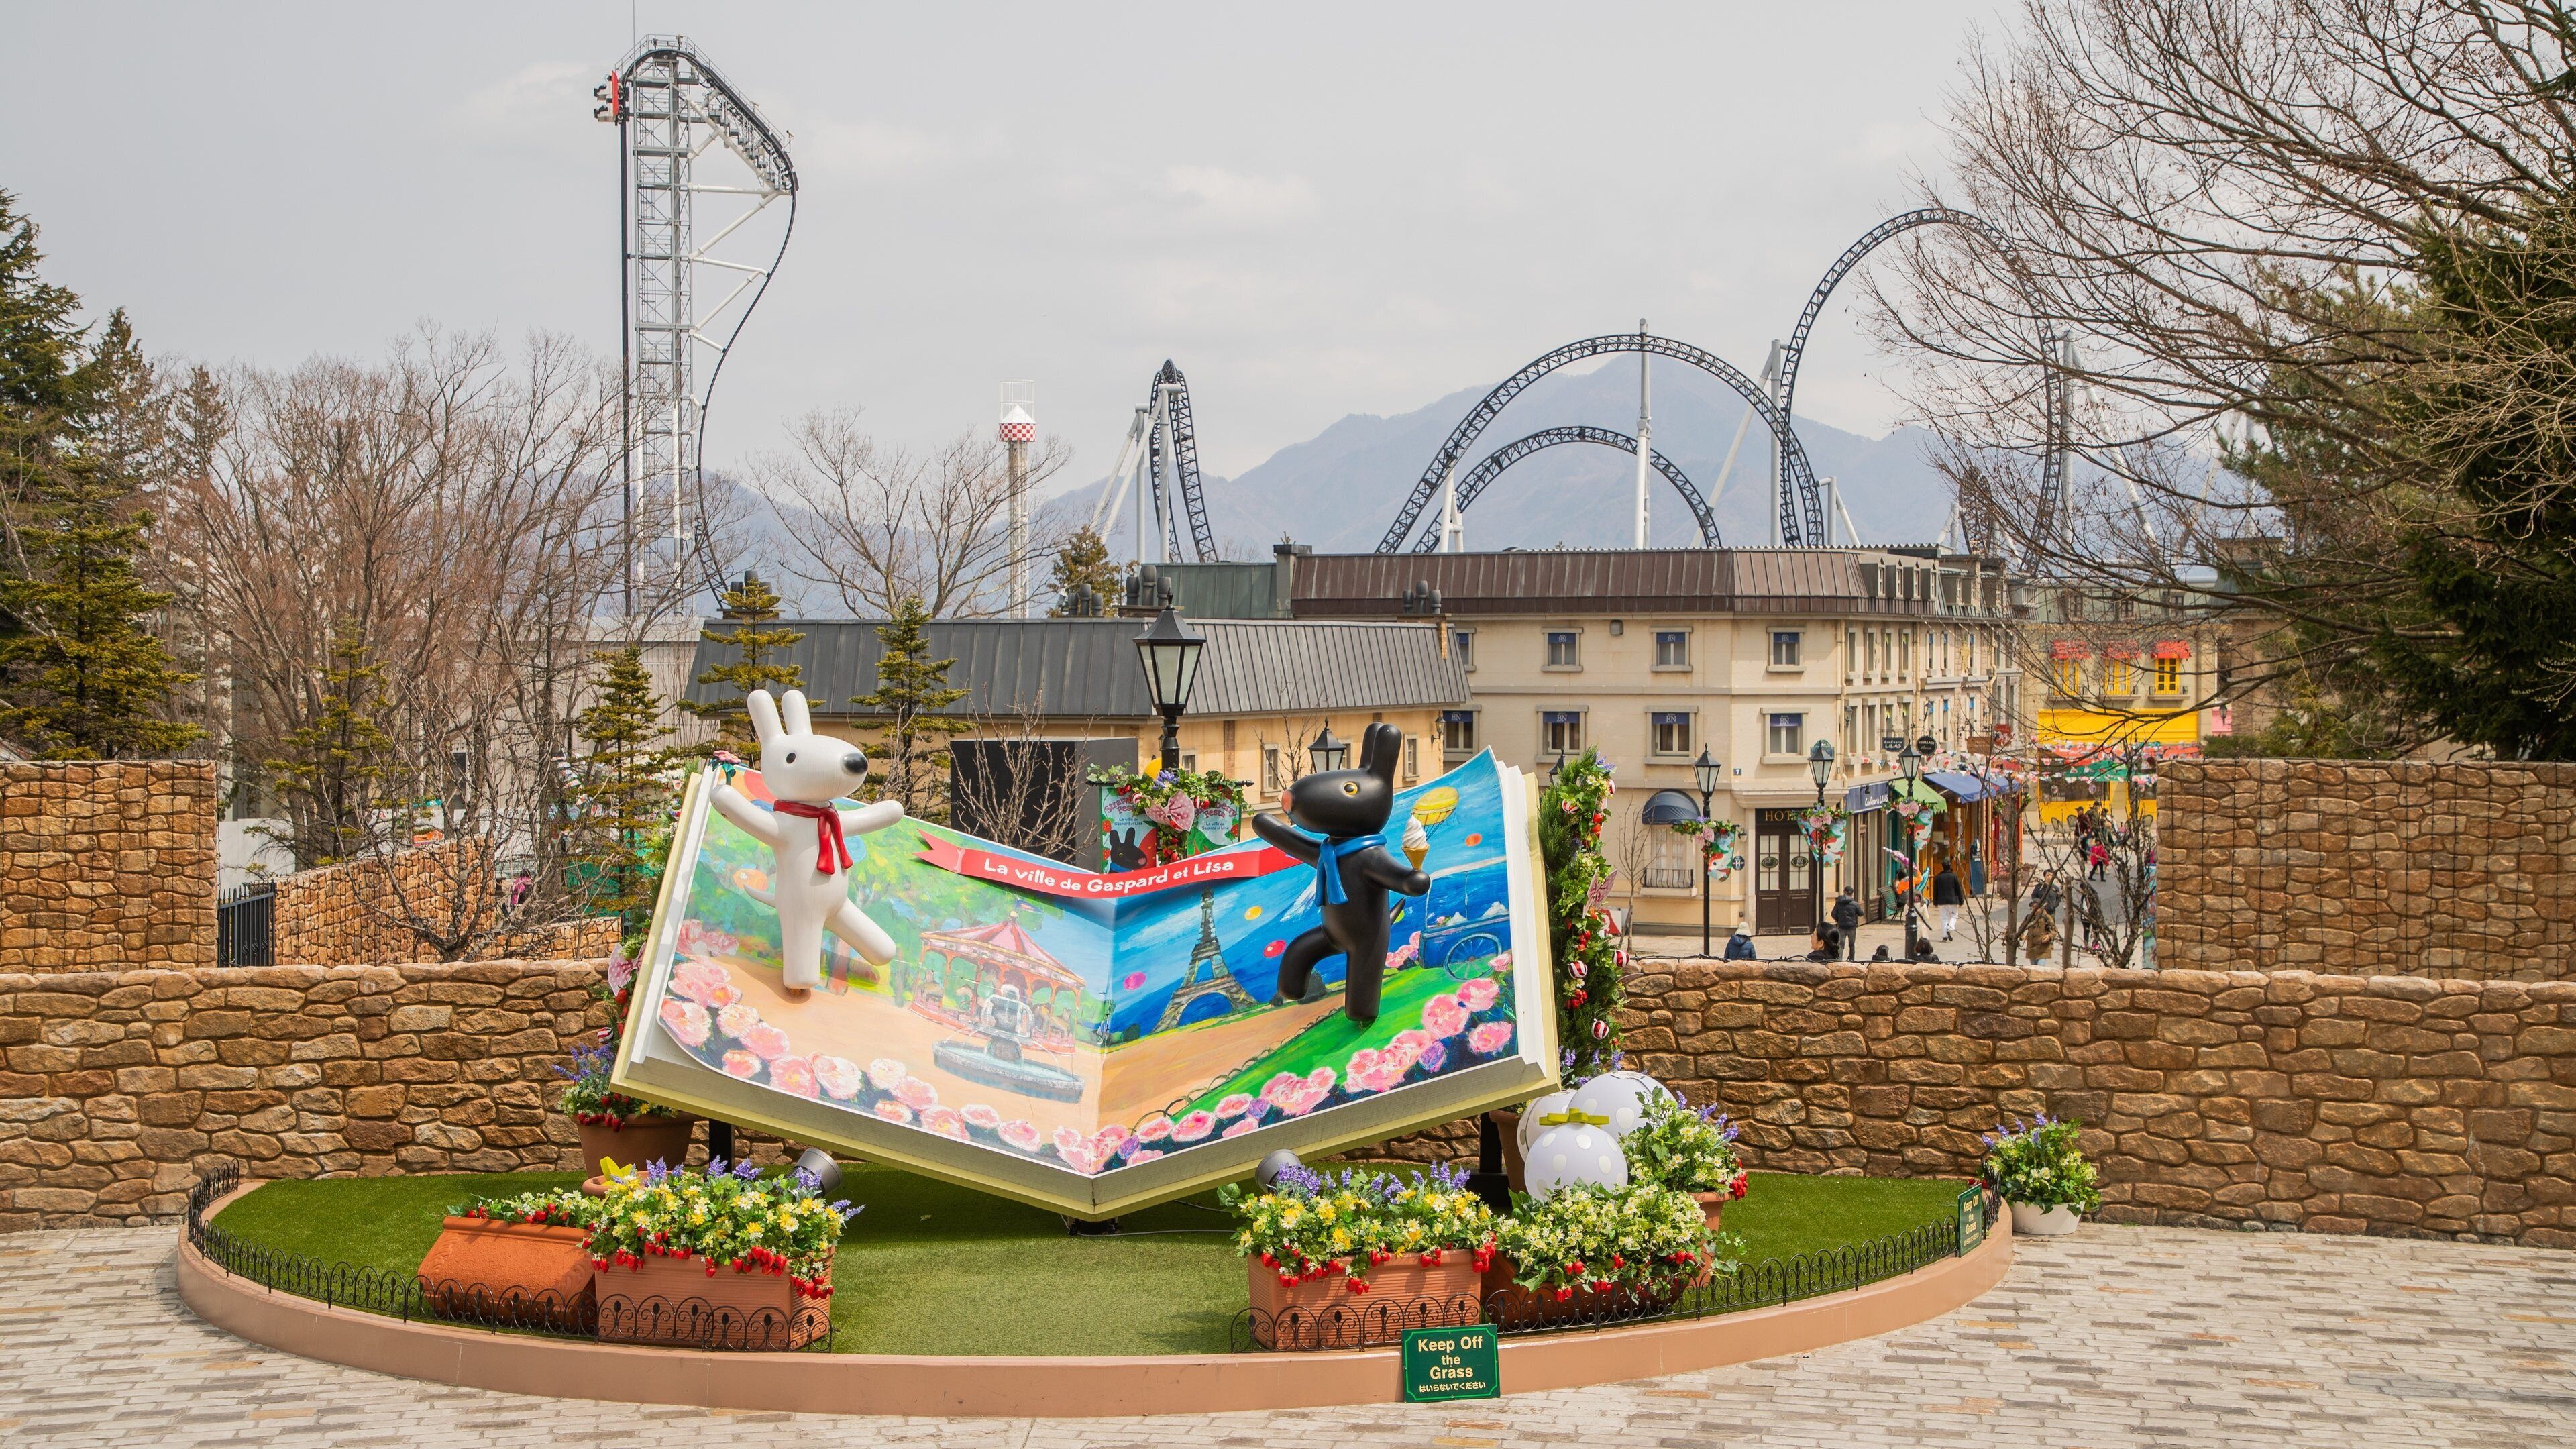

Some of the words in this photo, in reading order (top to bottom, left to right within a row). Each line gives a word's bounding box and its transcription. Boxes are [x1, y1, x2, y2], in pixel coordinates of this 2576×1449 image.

[984, 858, 1008, 875] La
[1014, 867, 1056, 886] ville
[1059, 878, 1081, 891] de
[1087, 869, 1168, 894] Gaspard
[1173, 867, 1189, 879] et
[1193, 859, 1234, 875] Lisa
[1964, 1201, 1972, 1213] Keep
[1417, 1339, 1455, 1354] Keep
[1460, 1336, 1483, 1350] Off
[1441, 1355, 1461, 1366] the
[1430, 1366, 1474, 1380] Grass
[1419, 1381, 1487, 1393] はいらないでください
